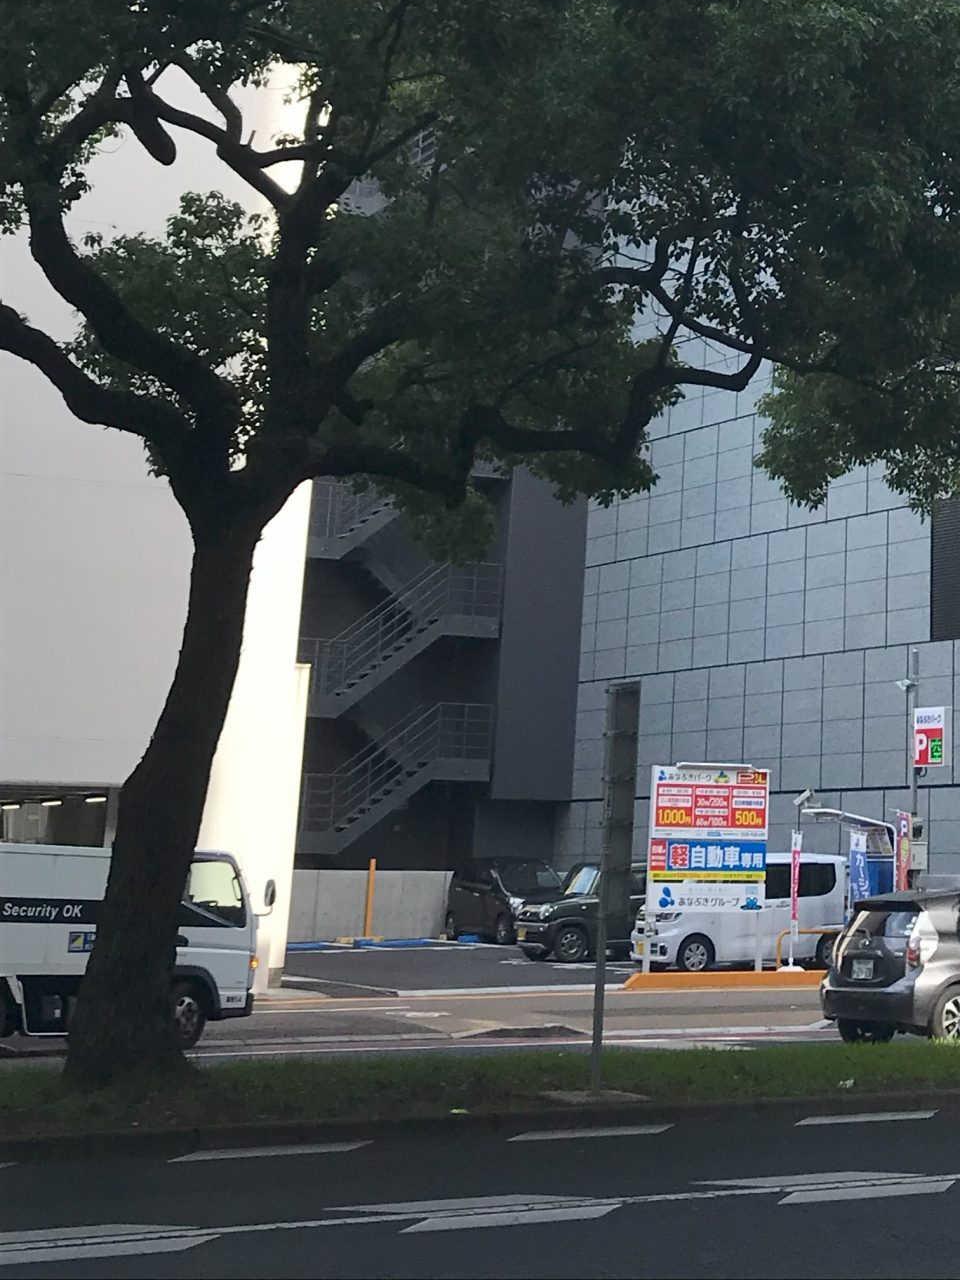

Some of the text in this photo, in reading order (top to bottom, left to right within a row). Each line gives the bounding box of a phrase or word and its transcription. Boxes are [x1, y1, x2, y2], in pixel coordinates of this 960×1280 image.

[914, 733, 928, 761] P
[735, 810, 762, 826] 500円
[669, 844, 763, 869] 軽自動車専用
[2, 902, 83, 921] Security OK
[678, 897, 740, 907] あなぶきグループ
